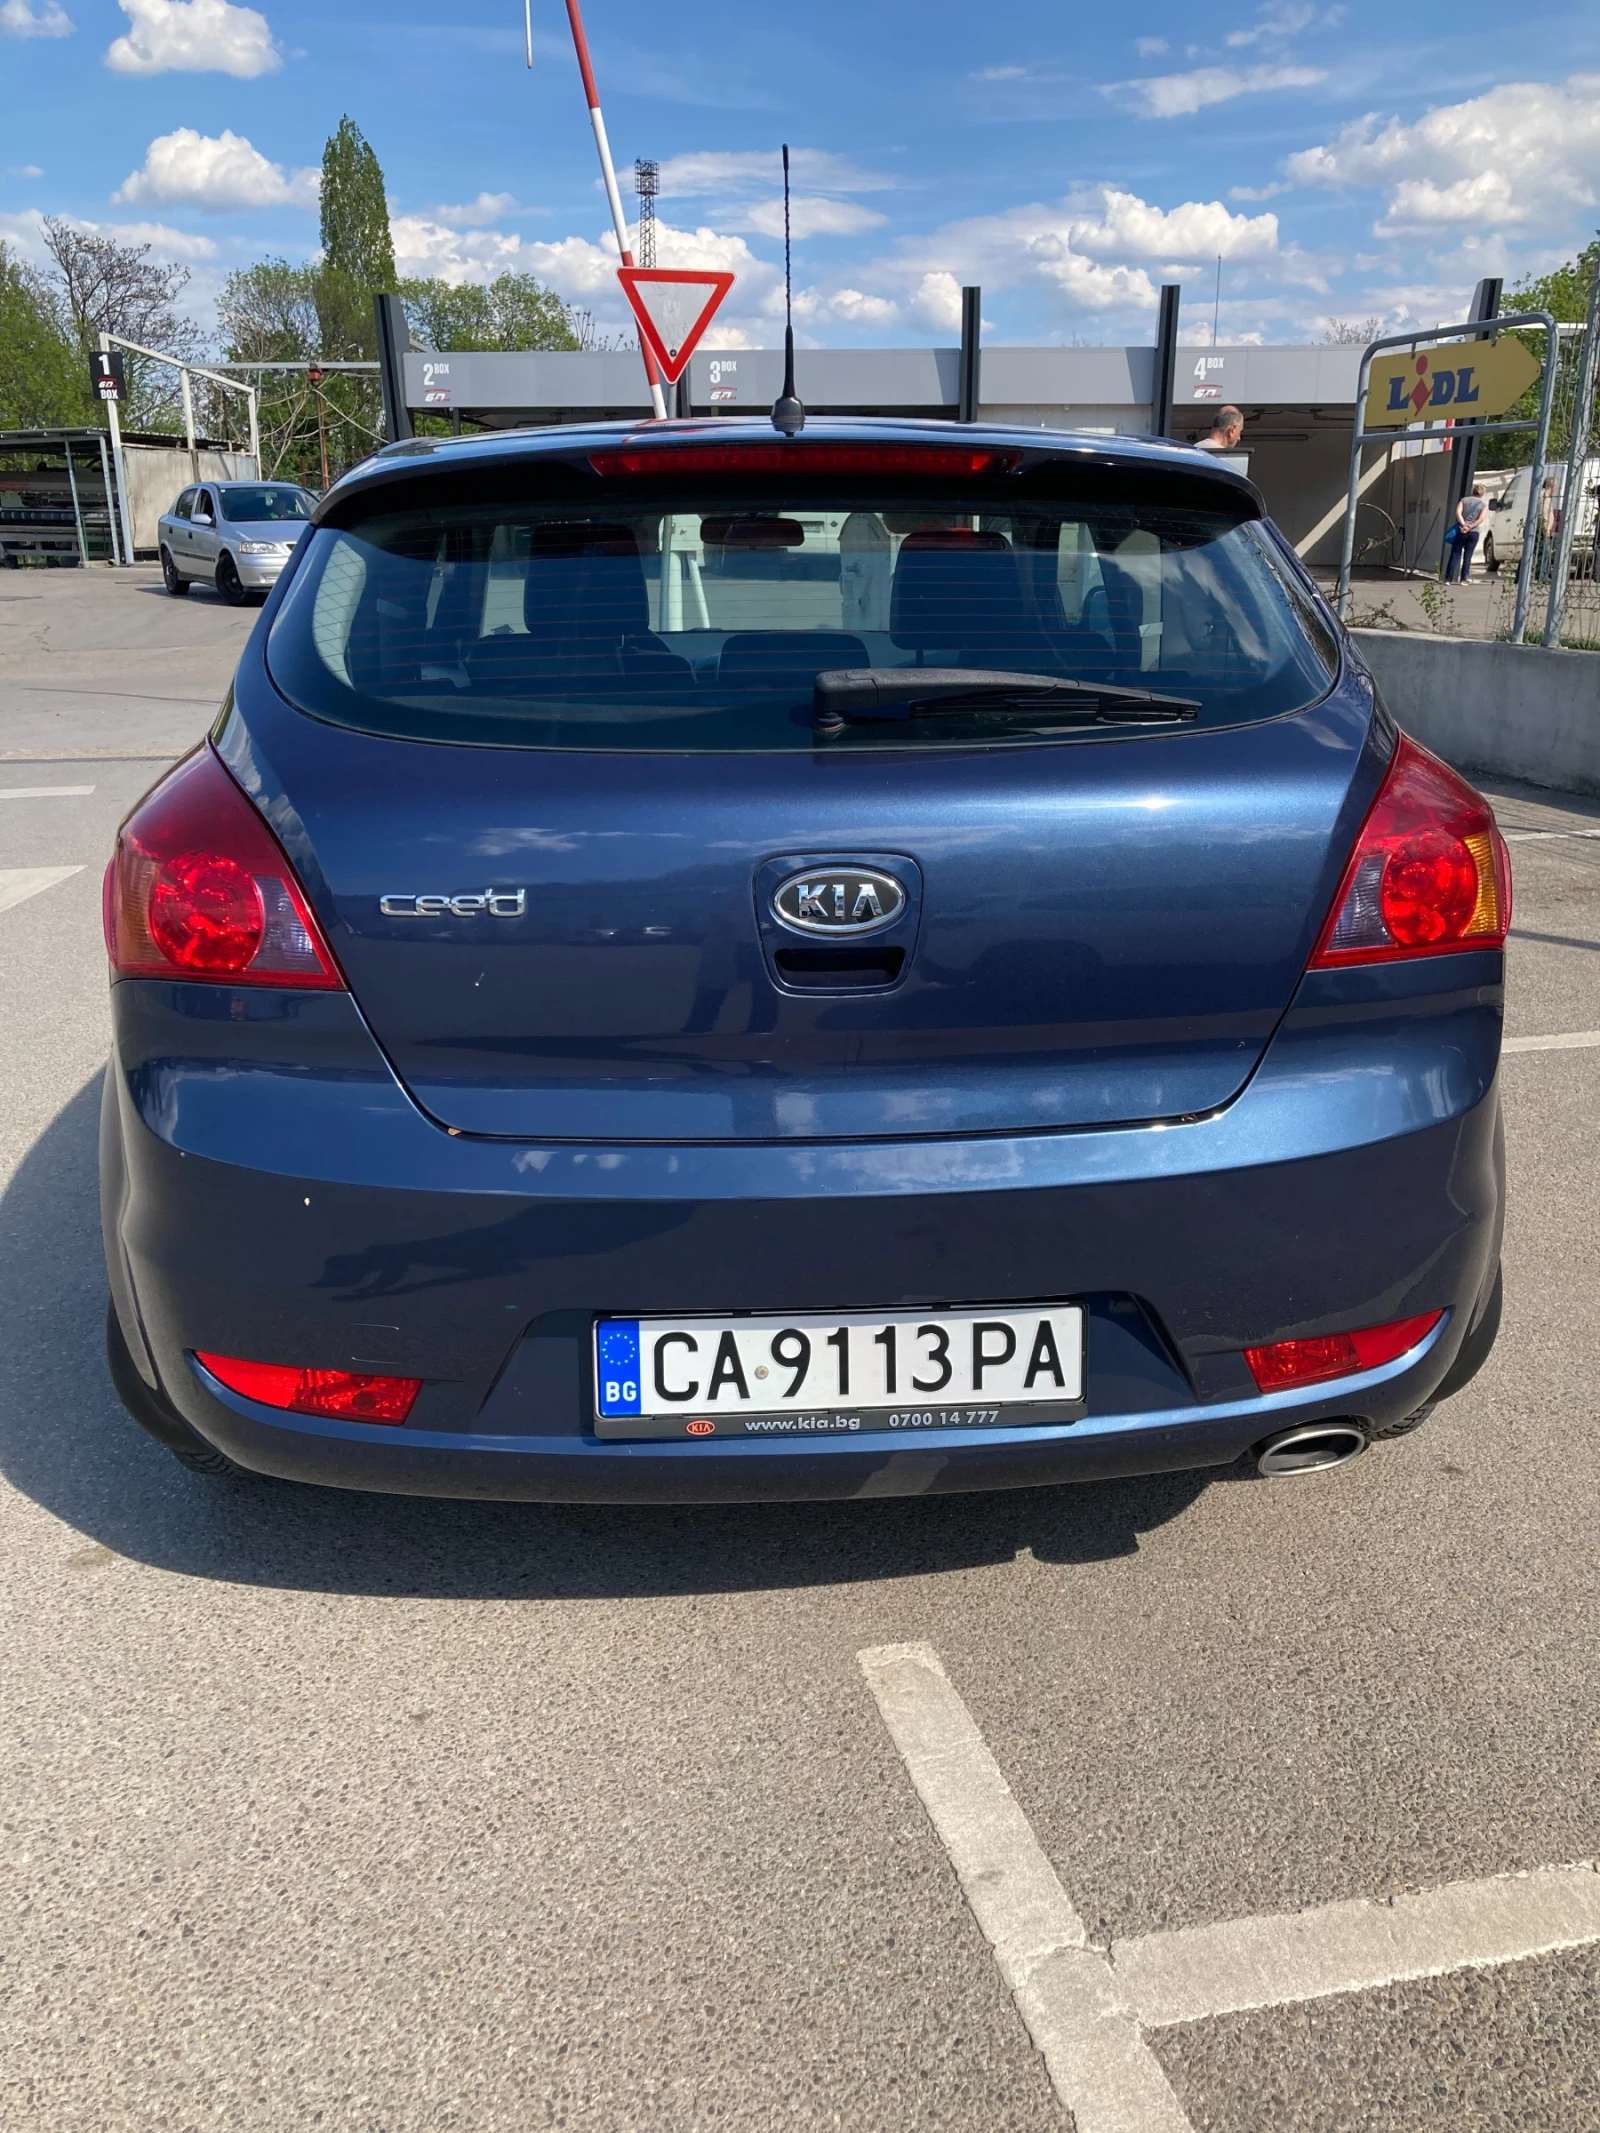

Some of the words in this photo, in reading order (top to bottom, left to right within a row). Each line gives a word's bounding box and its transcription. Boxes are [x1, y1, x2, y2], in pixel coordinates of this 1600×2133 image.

[98, 354, 110, 375] 1
[423, 363, 435, 386] 2
[434, 363, 450, 374] BOX
[710, 360, 721, 384] 3
[721, 360, 737, 372] BOX
[1194, 357, 1207, 380] 4
[1207, 357, 1224, 369] BOX
[100, 389, 119, 400] BOX
[797, 884, 884, 918] KIA
[605, 1381, 637, 1402] BG
[691, 1422, 711, 1433] KIA
[745, 1415, 861, 1431] www.kia.bg
[889, 1413, 933, 1427] 0700
[939, 1411, 961, 1425] 14
[965, 1410, 999, 1424] 777
